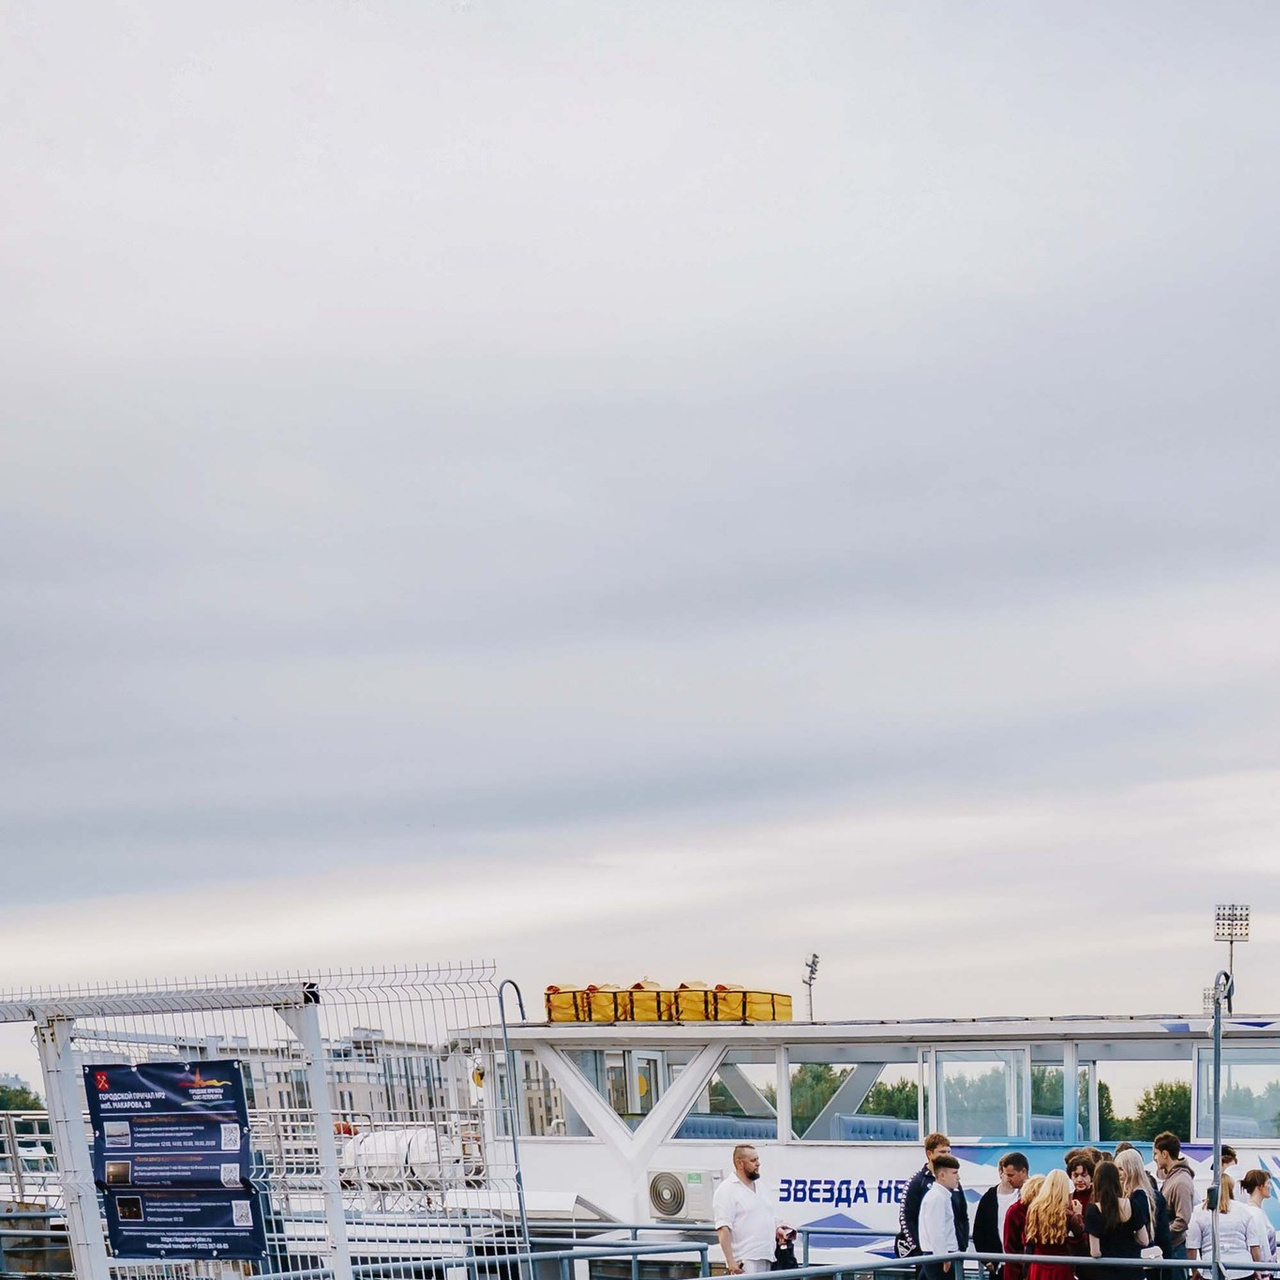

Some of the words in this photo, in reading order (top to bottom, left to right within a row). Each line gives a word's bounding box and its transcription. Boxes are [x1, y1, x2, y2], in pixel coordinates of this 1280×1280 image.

[99, 1091, 133, 1101] ГОРОДСКОЙ
[133, 1092, 155, 1100] ПРИЧАЛ
[112, 1101, 144, 1109] МАКАРОВА,
[779, 1179, 869, 1208] ЗВЕЗДА
